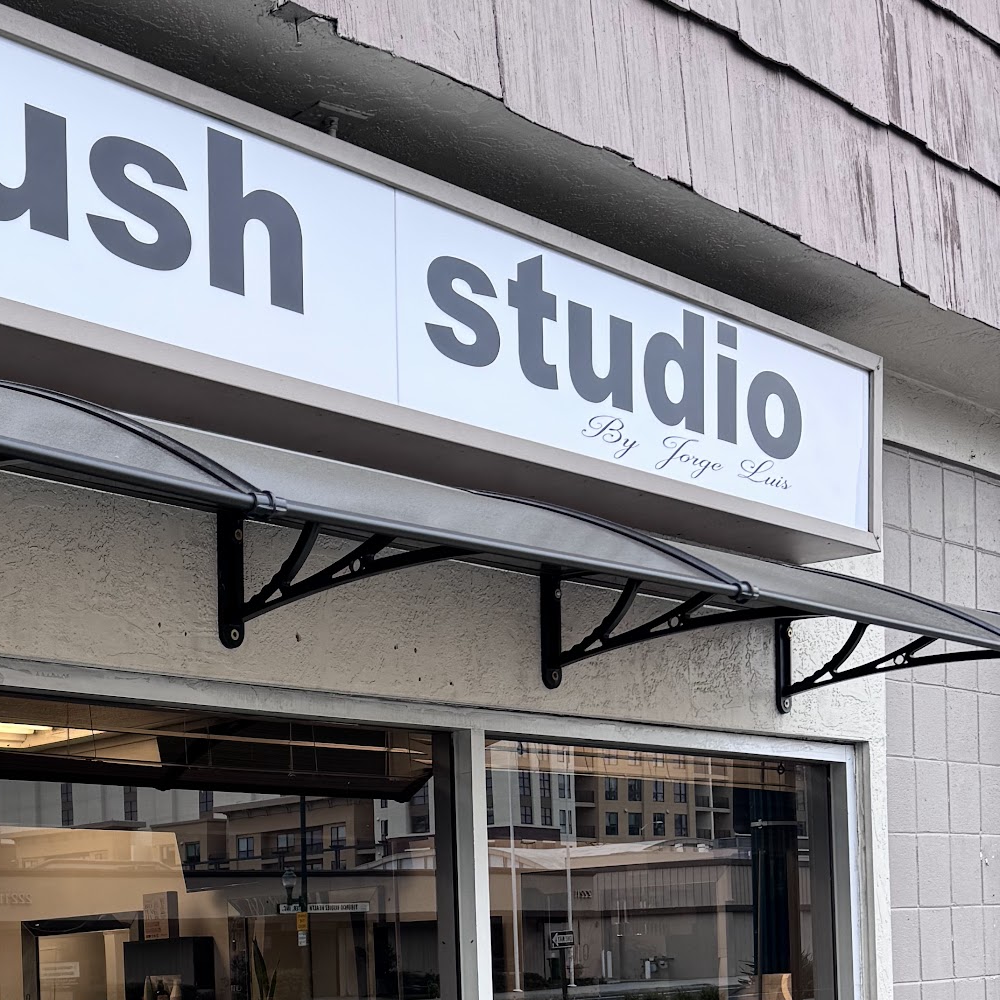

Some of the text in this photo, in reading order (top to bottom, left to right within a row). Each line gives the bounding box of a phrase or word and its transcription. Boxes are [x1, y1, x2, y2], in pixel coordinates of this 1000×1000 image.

[425, 254, 802, 459] studio
[581, 415, 792, 490] By Jorge Luis
